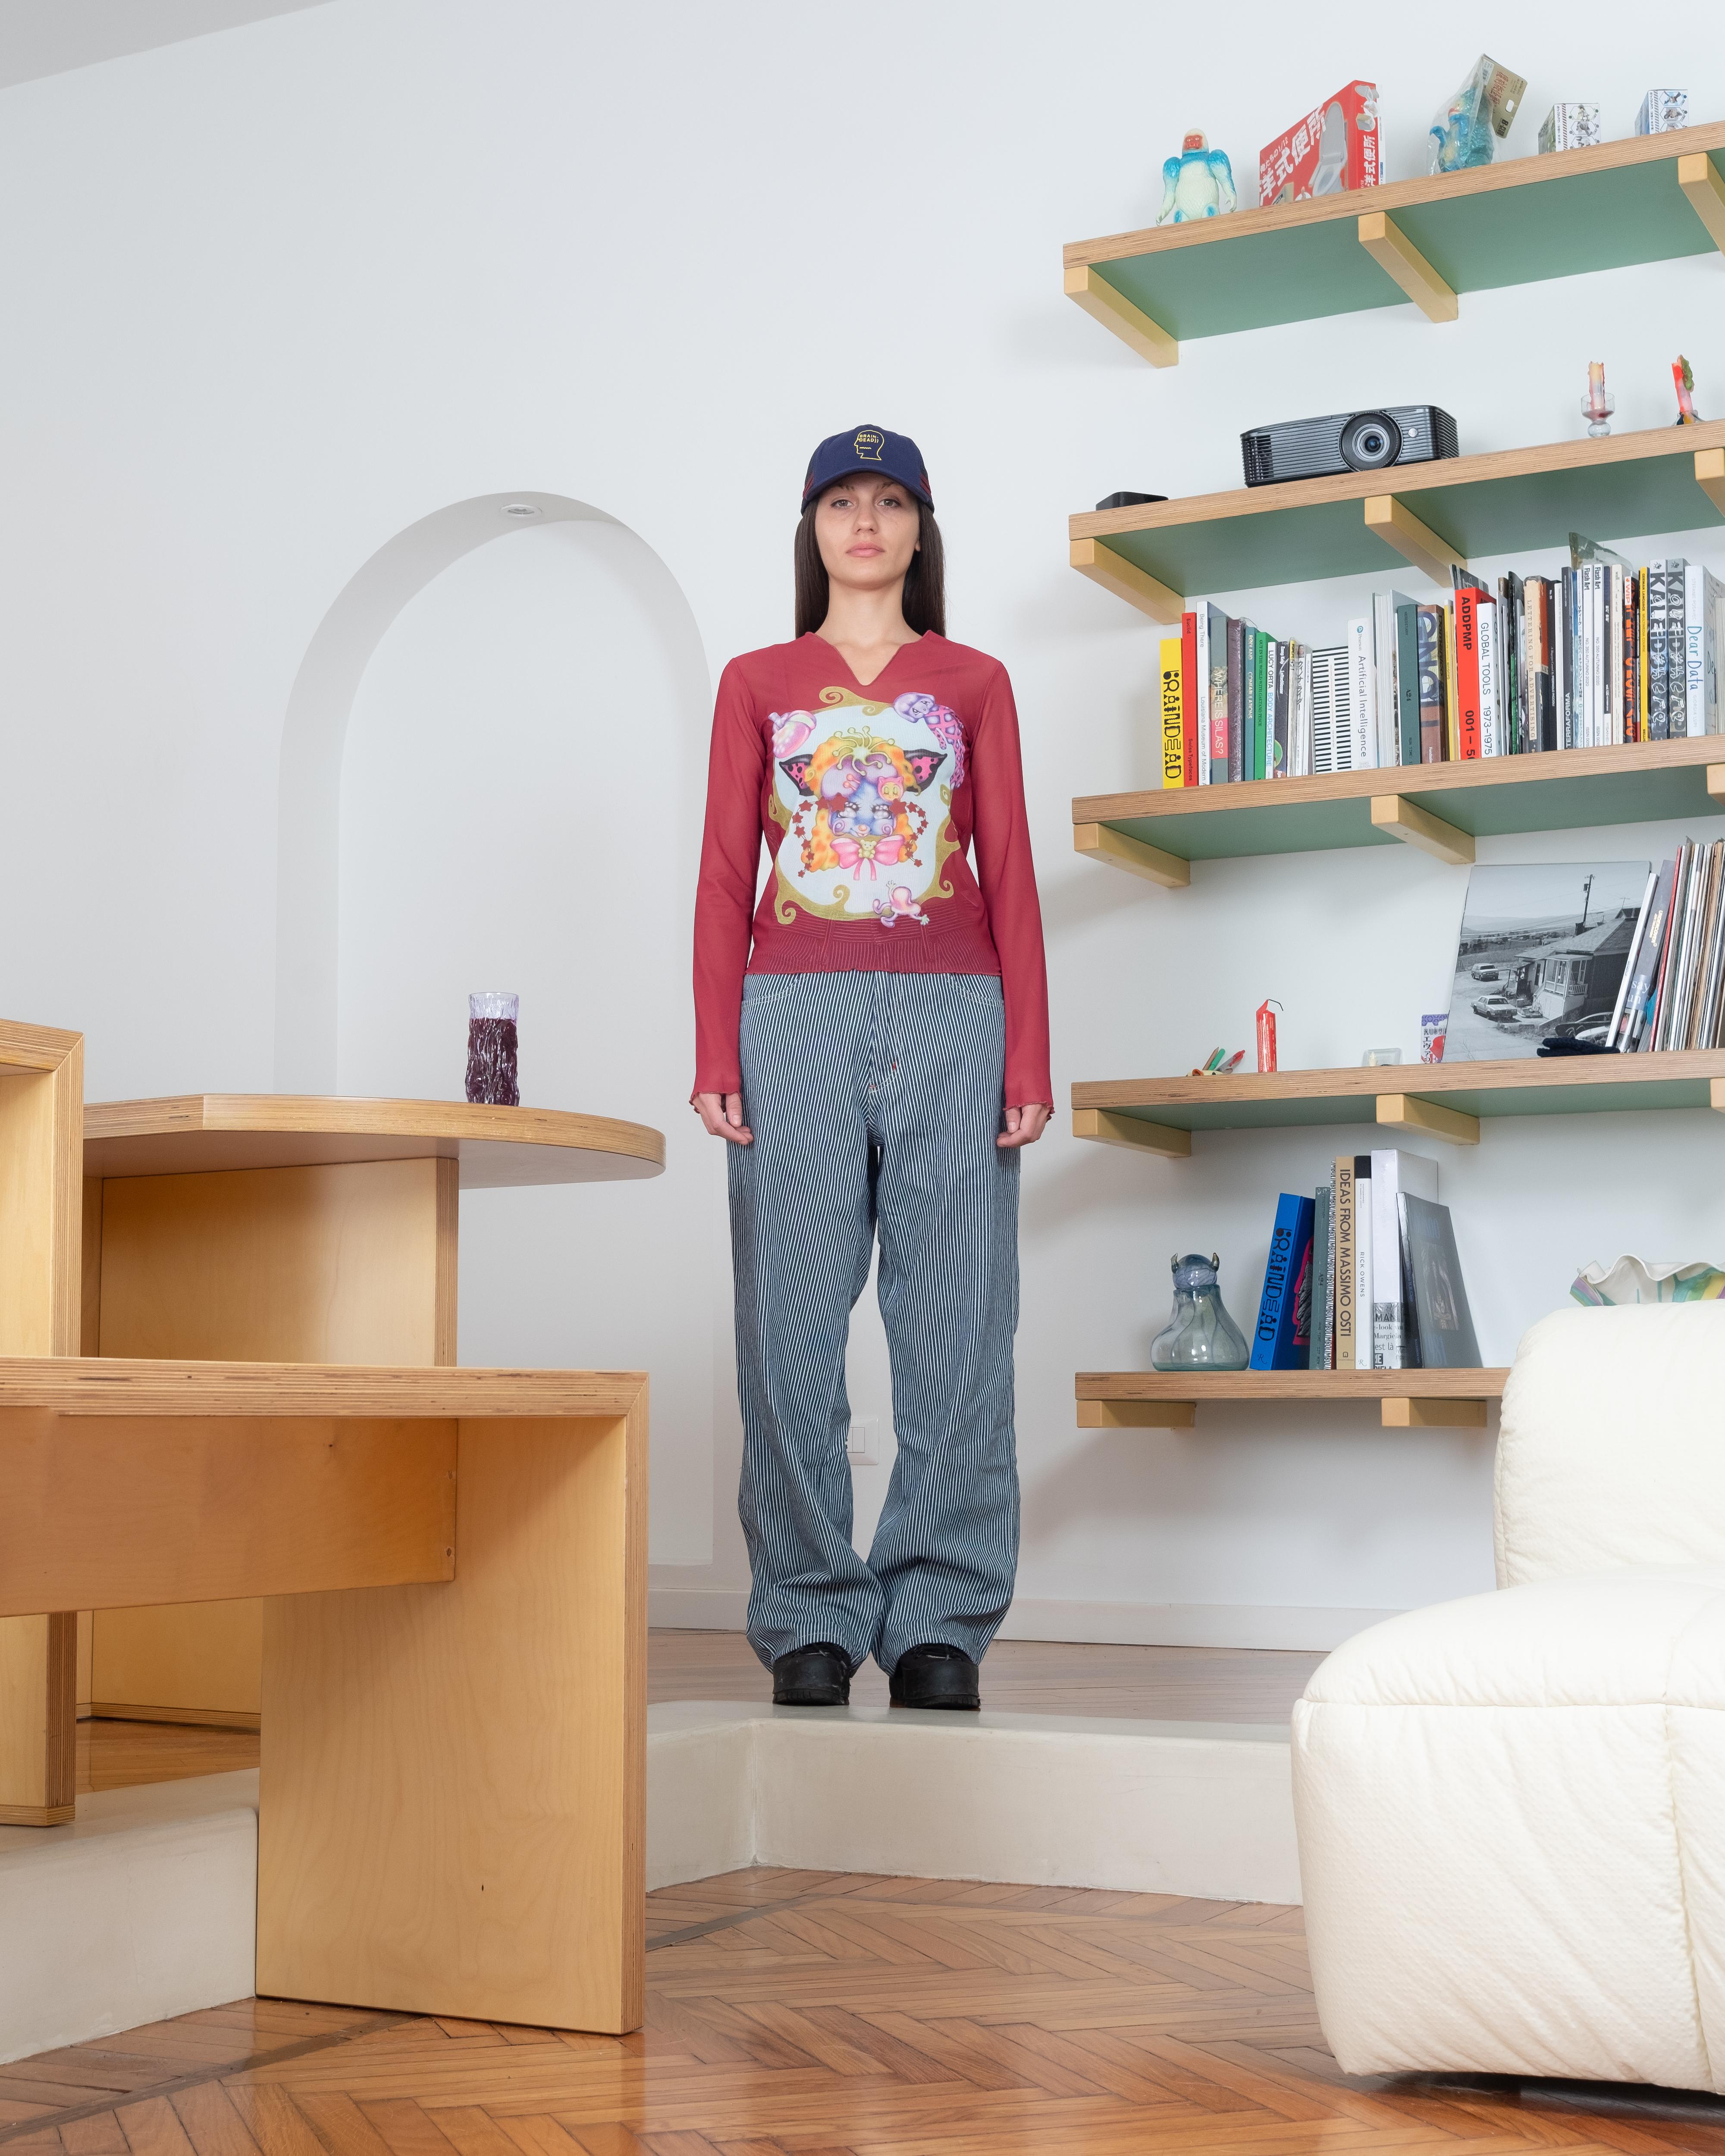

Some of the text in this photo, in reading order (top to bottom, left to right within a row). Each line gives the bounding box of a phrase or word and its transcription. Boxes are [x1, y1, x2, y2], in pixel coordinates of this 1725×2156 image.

[1462, 597, 1472, 650] ADDPMP
[1687, 626, 1703, 656] Dear
[1358, 656, 1367, 697] Artificial
[1481, 623, 1492, 755] GLOBAL TOOLS 1973-1975
[1687, 661, 1704, 690] Data
[1214, 671, 1224, 754] WHERE IS SILAS?
[1358, 700, 1368, 757] Intelligence
[1465, 710, 1475, 732] 001
[1340, 1169, 1351, 1336] IDEAS FROM MASSIMO OSTI
